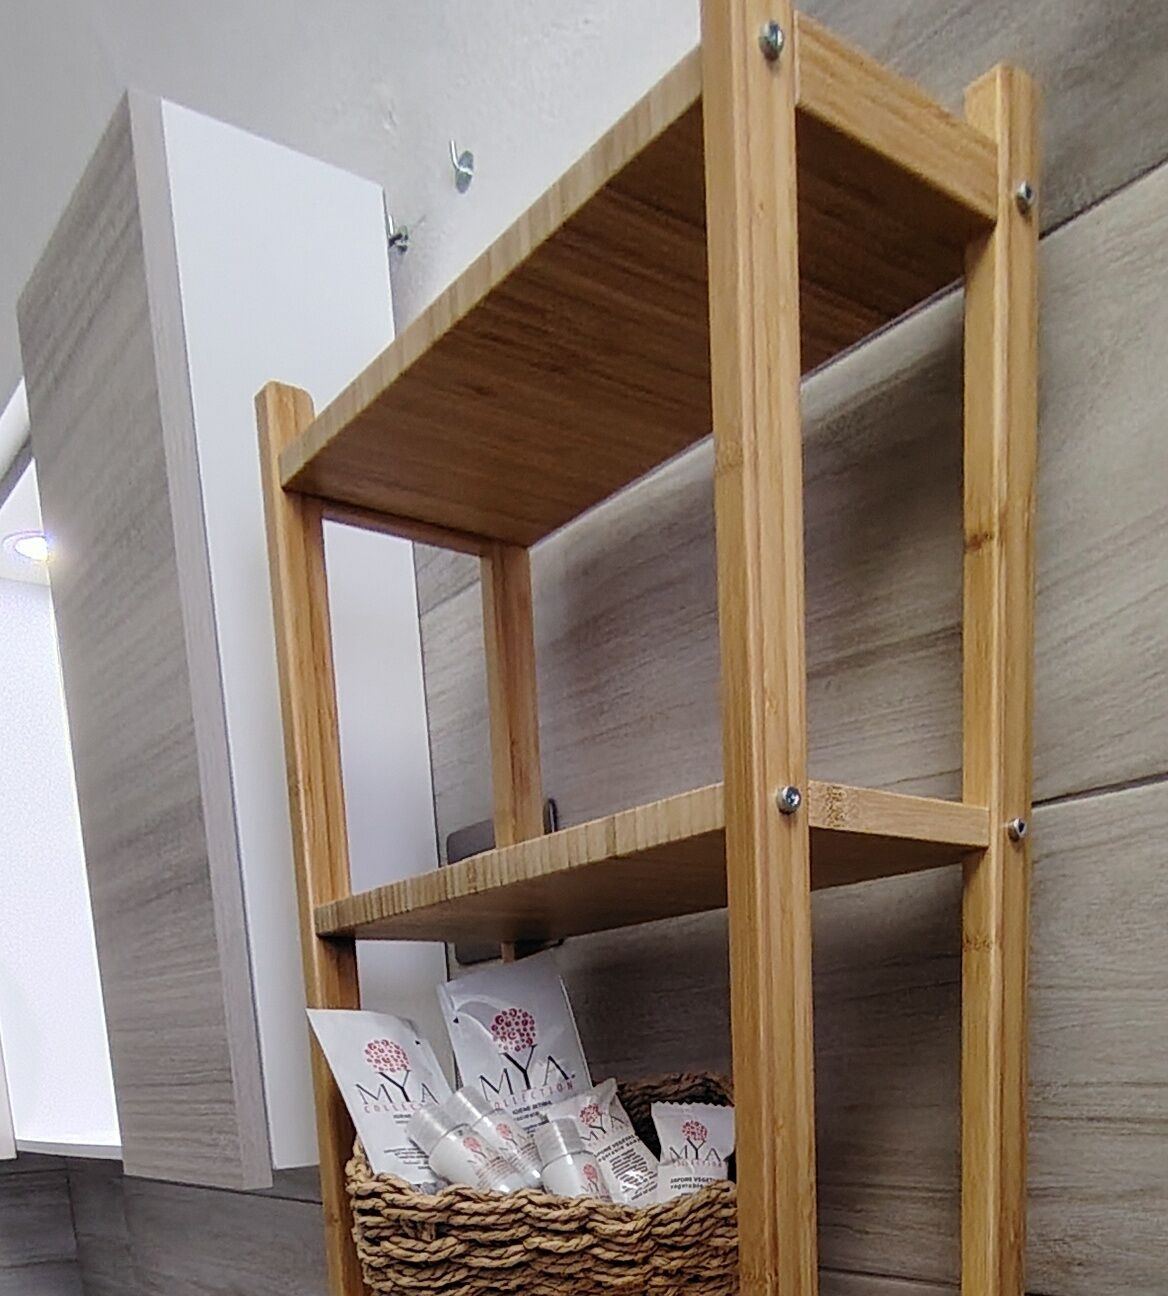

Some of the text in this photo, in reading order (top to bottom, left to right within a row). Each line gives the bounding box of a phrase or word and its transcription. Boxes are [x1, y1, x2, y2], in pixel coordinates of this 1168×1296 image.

[355, 1069, 440, 1106] MYA
[494, 1081, 574, 1110] OLLECTION
[669, 1137, 721, 1163] MYA
